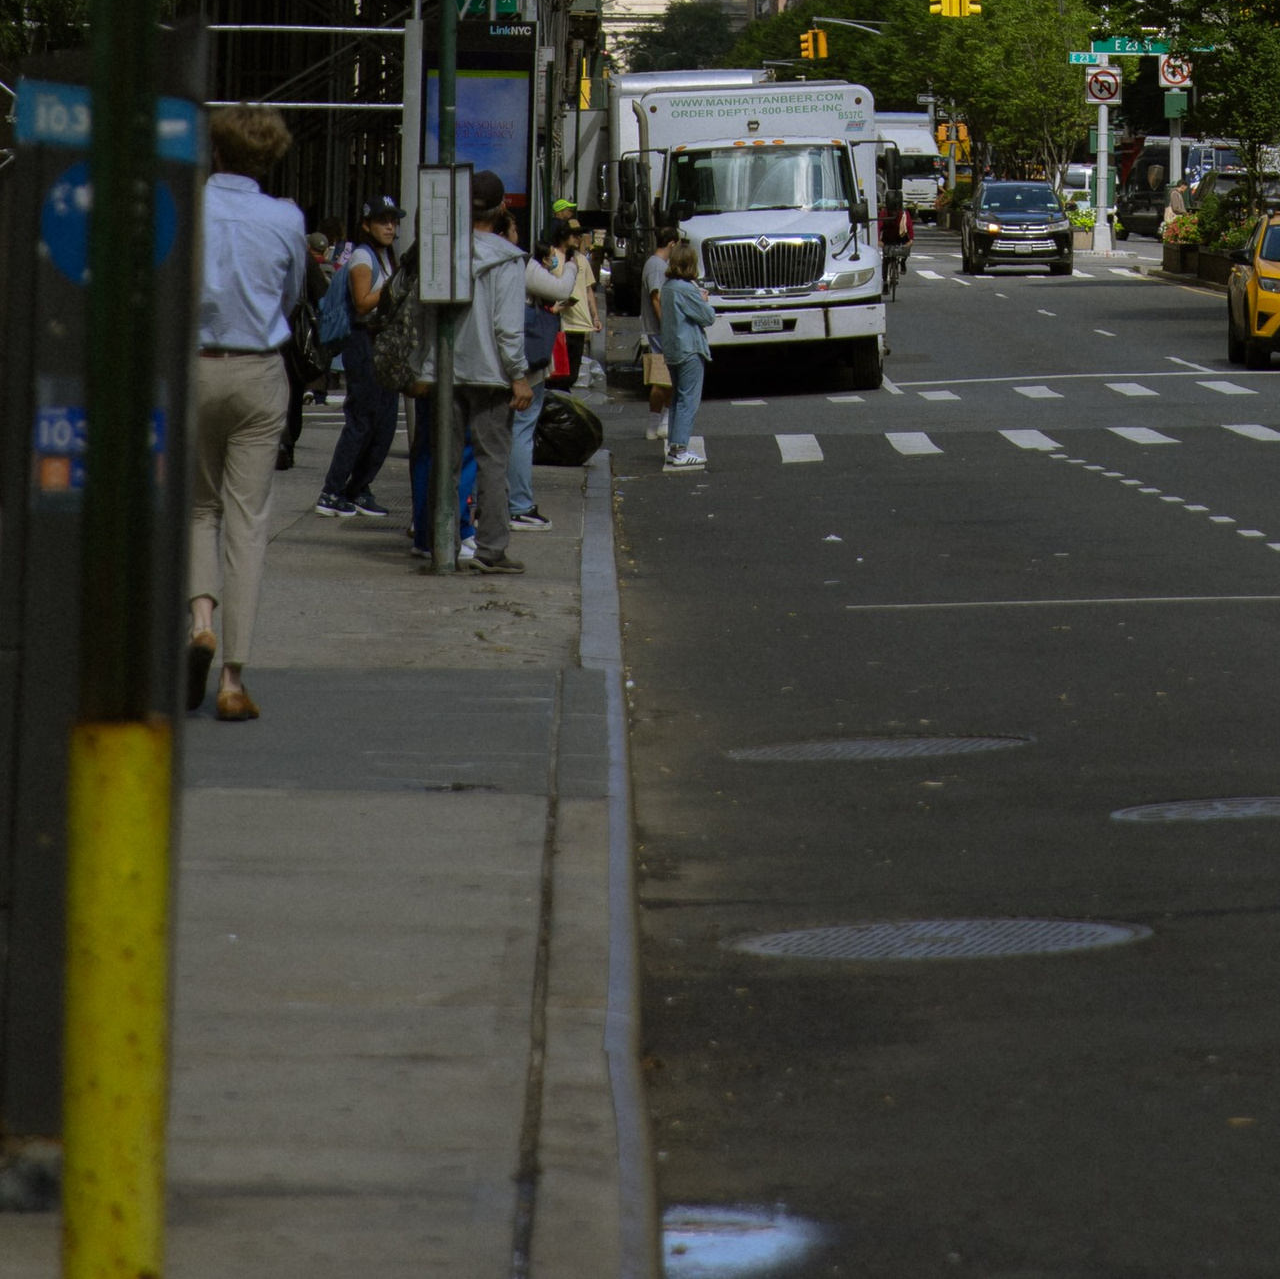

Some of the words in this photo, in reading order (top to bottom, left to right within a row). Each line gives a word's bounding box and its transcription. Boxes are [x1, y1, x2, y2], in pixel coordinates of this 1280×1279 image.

[489, 25, 532, 36] LinkNYC
[1115, 39, 1121, 51] E
[1126, 41, 1138, 51] 23
[669, 92, 844, 108] WWW.MANHATTANBEER.COM
[671, 110, 713, 119] ORDER
[838, 110, 864, 120] B537C
